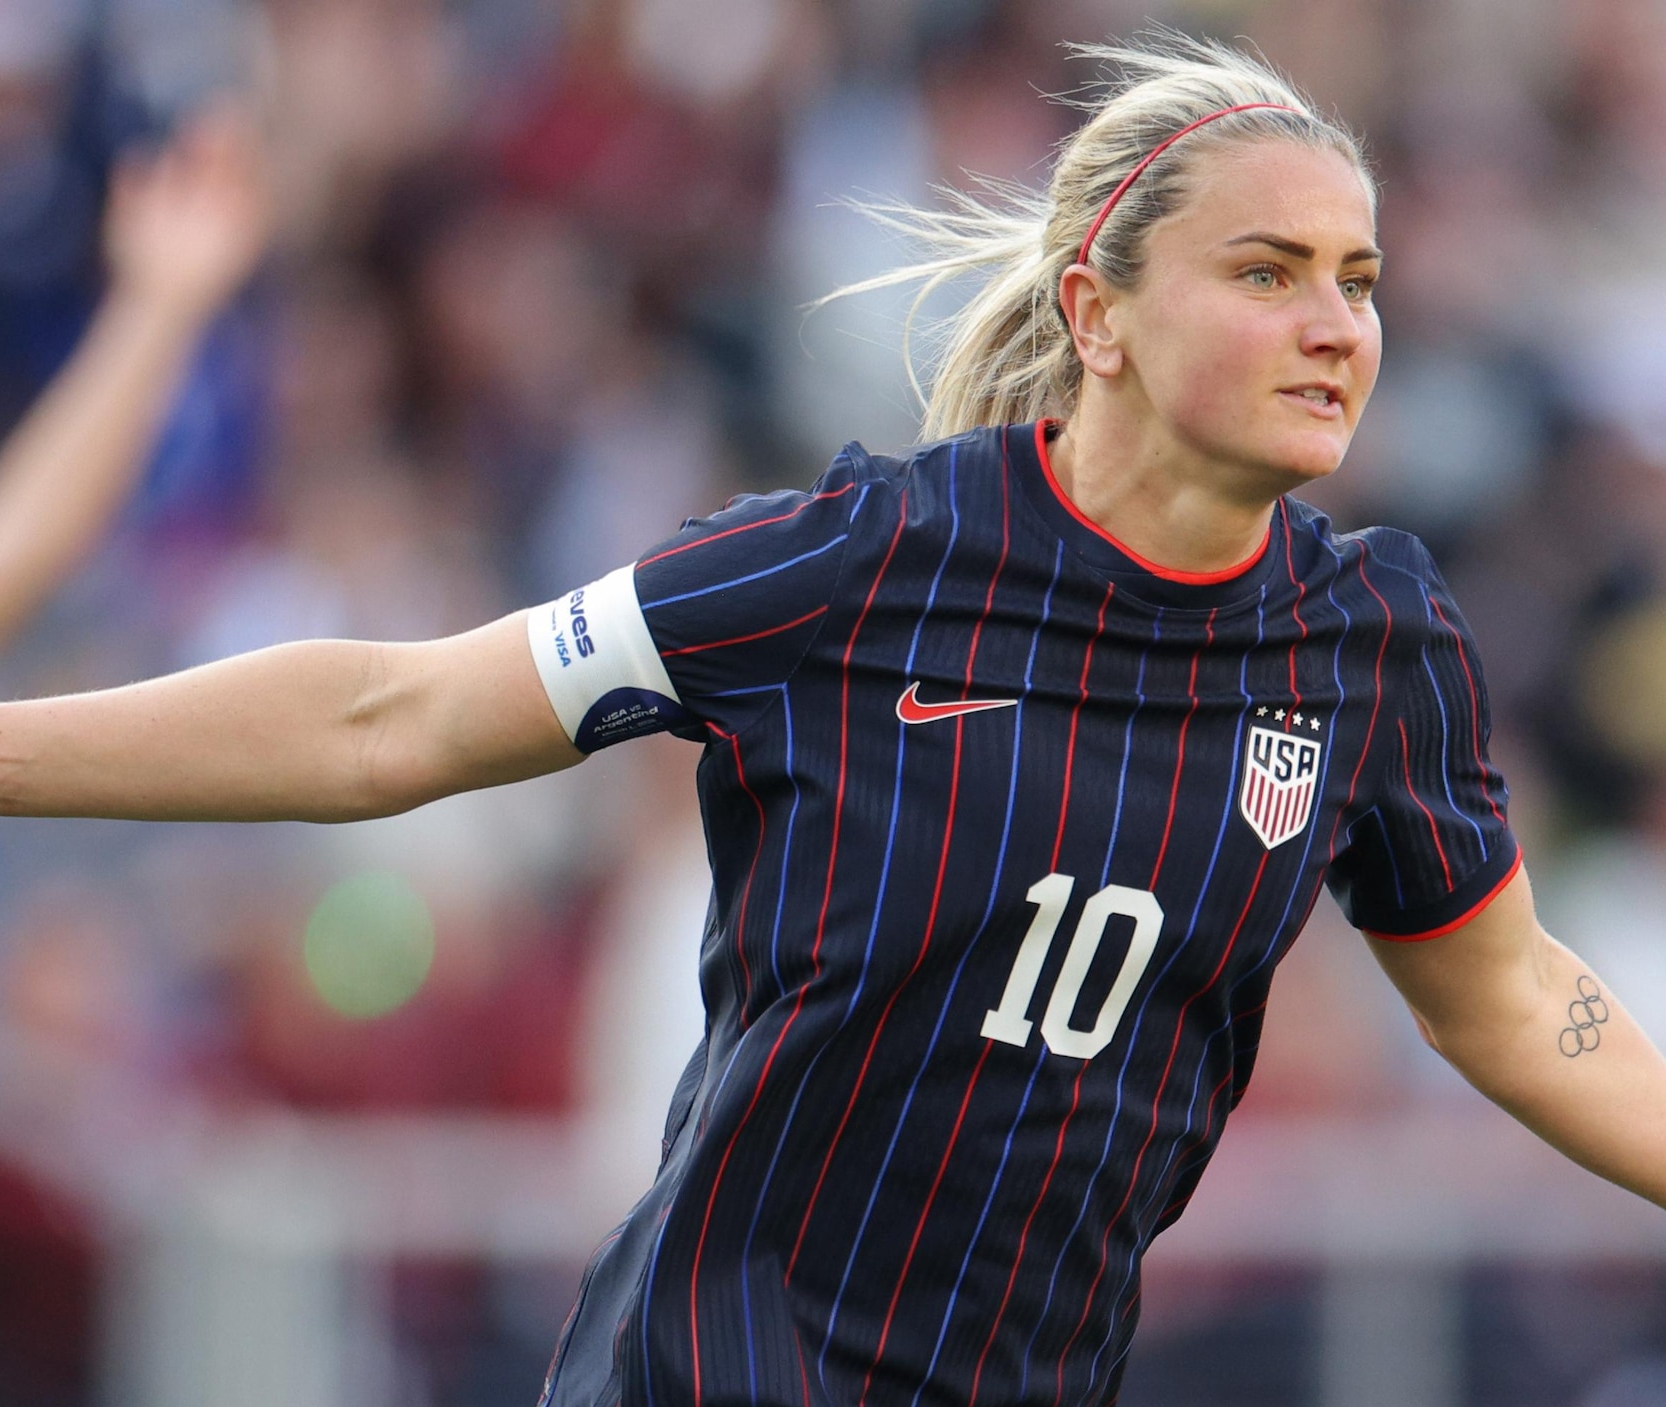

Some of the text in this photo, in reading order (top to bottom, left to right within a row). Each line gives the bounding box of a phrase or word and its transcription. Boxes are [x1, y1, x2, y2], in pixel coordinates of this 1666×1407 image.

[555, 631, 571, 667] VISA
[602, 708, 627, 723] USA
[1253, 733, 1316, 783] USA
[980, 872, 1165, 1060] 10
